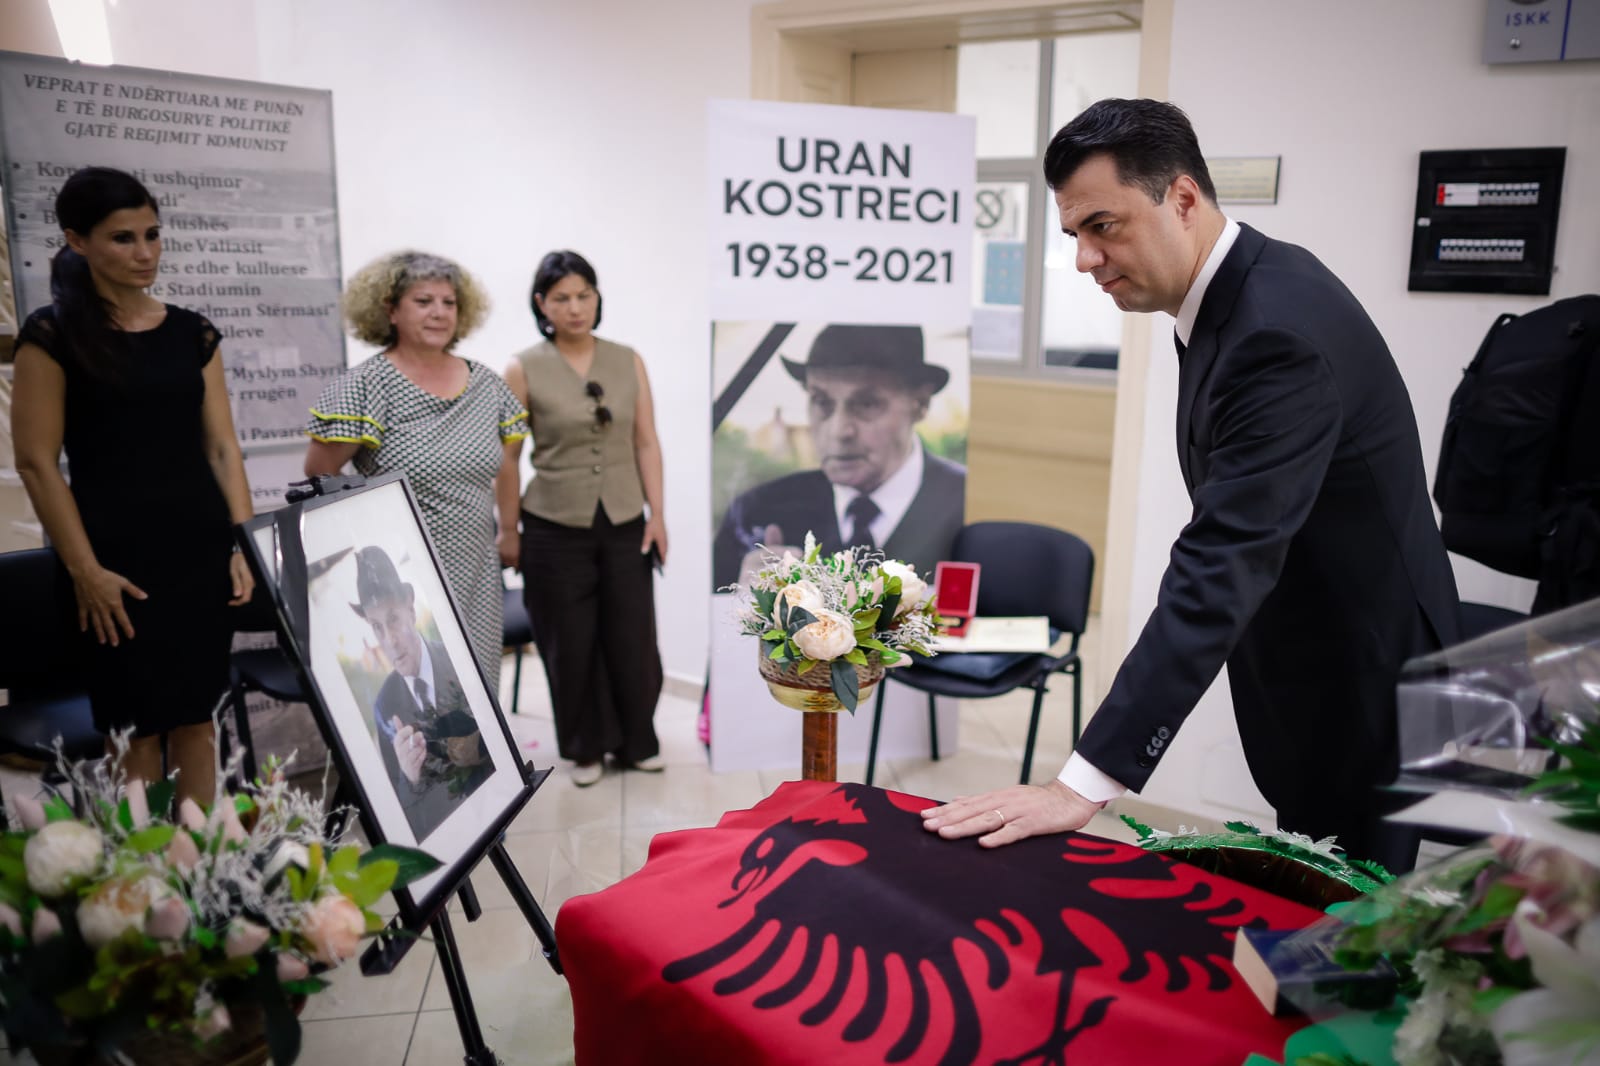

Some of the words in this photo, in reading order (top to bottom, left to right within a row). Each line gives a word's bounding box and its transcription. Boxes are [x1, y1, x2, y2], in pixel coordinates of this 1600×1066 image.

[1505, 10, 1551, 27] ISKK
[23, 73, 99, 96] VEPRAT
[103, 83, 115, 98] E
[118, 84, 220, 108] NDËRTUARA
[223, 97, 249, 112] ME
[55, 99, 67, 113] E
[74, 100, 96, 116] TË
[102, 103, 215, 128] BURGOSURVE
[64, 121, 118, 139] GJATË
[123, 126, 202, 146] REGJIMIT
[206, 133, 288, 153] KOMUNIST
[777, 136, 912, 179] URAN
[152, 170, 243, 190] ushqimor
[723, 178, 960, 224] KOSTRECI
[184, 259, 231, 276] edhe
[236, 261, 309, 276] kulluese
[167, 281, 262, 298] Stadiumin
